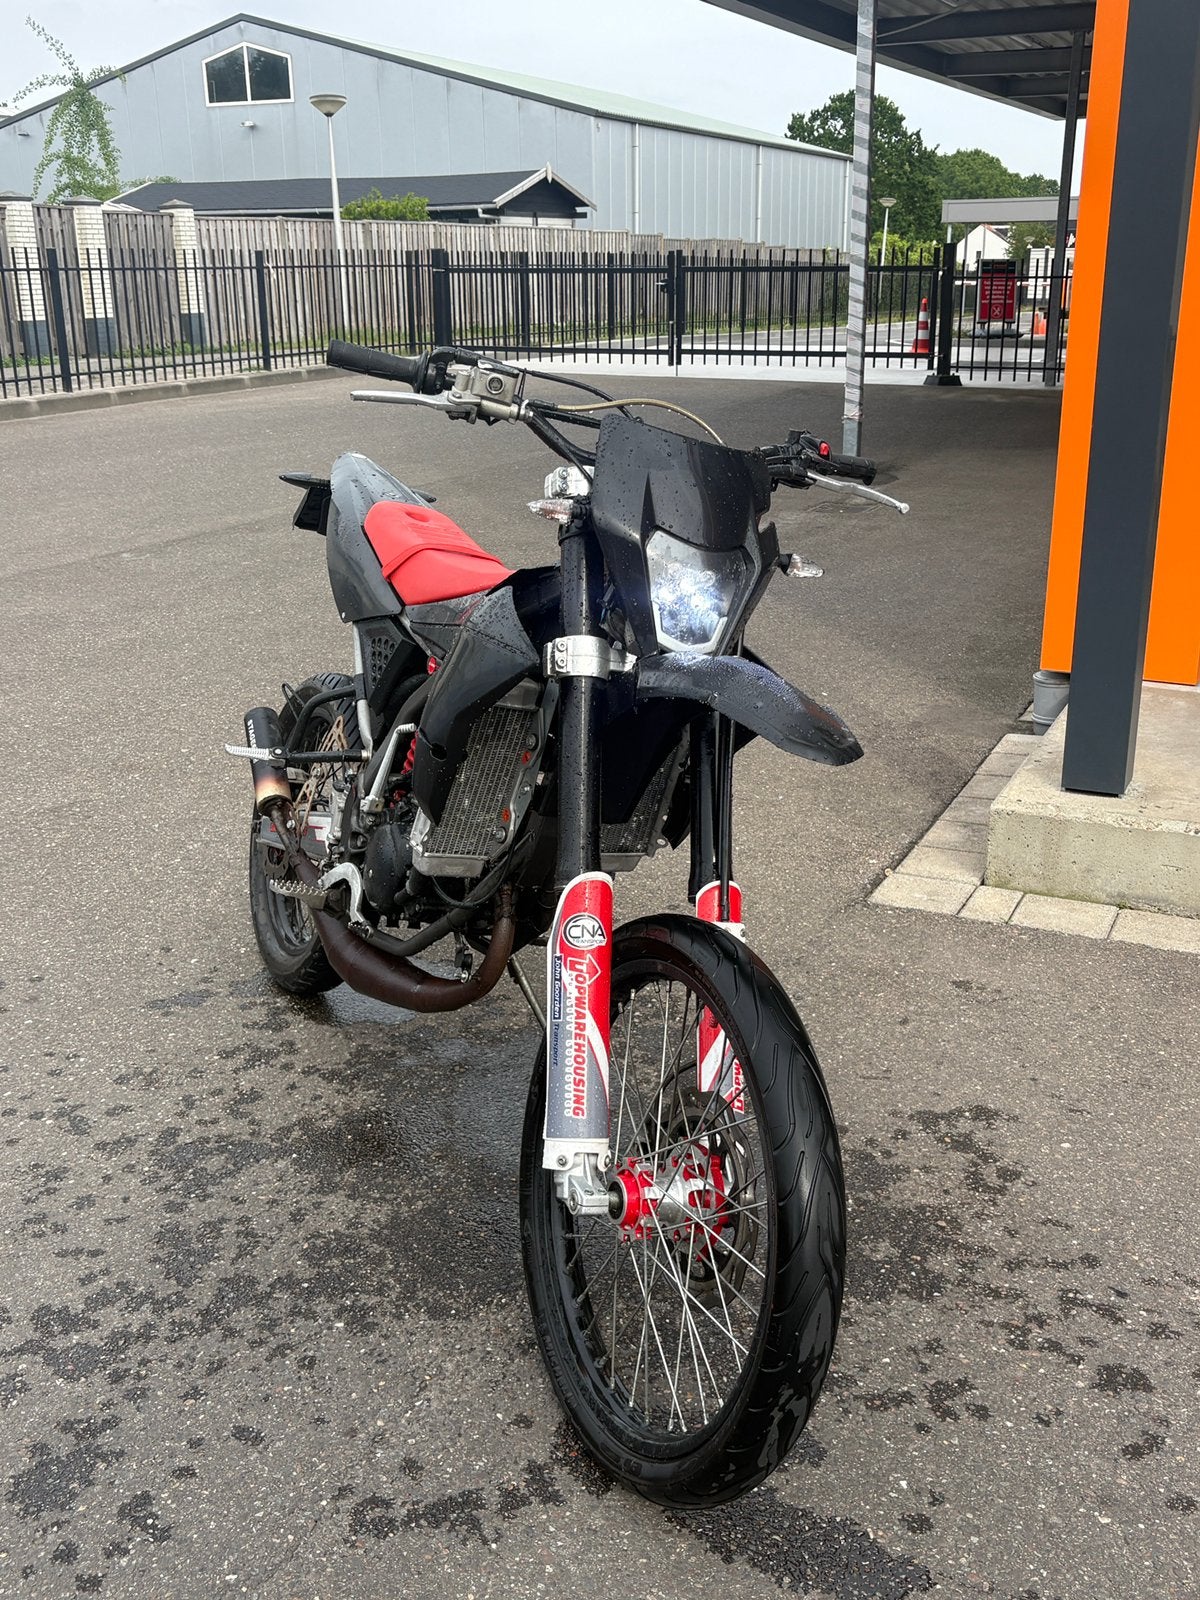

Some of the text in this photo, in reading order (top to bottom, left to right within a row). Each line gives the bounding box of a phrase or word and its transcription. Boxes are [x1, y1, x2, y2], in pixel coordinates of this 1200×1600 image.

[568, 924, 606, 940] CNA
[552, 1022, 560, 1067] Transport
[572, 961, 588, 1118] TOPWAREHOUSING
[734, 1061, 744, 1111] TOPW
